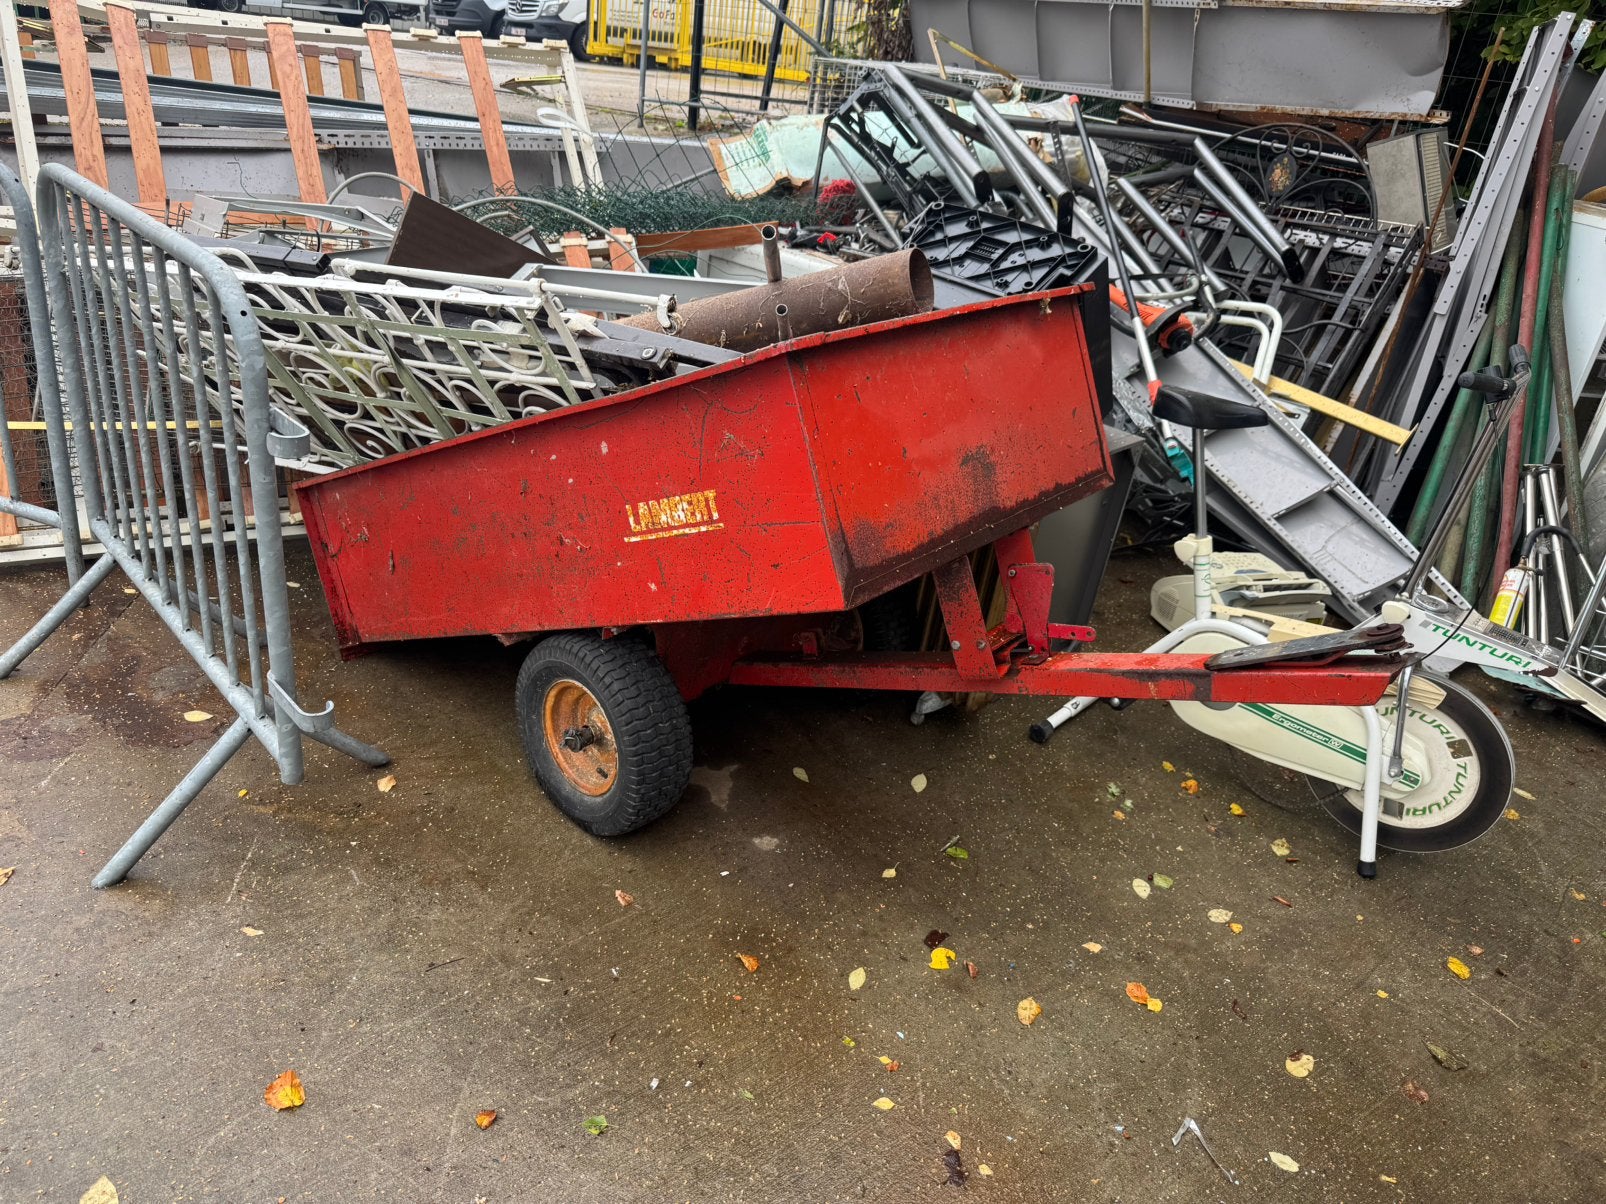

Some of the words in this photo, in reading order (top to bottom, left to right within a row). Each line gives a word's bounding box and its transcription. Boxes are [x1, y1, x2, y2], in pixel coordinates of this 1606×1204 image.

[626, 489, 719, 532] LAMBERT
[1430, 623, 1532, 669] TUNTURI
[1271, 712, 1329, 743] Ergometer
[1375, 705, 1456, 740] UNTURI
[1405, 762, 1468, 816] TUNTURI
